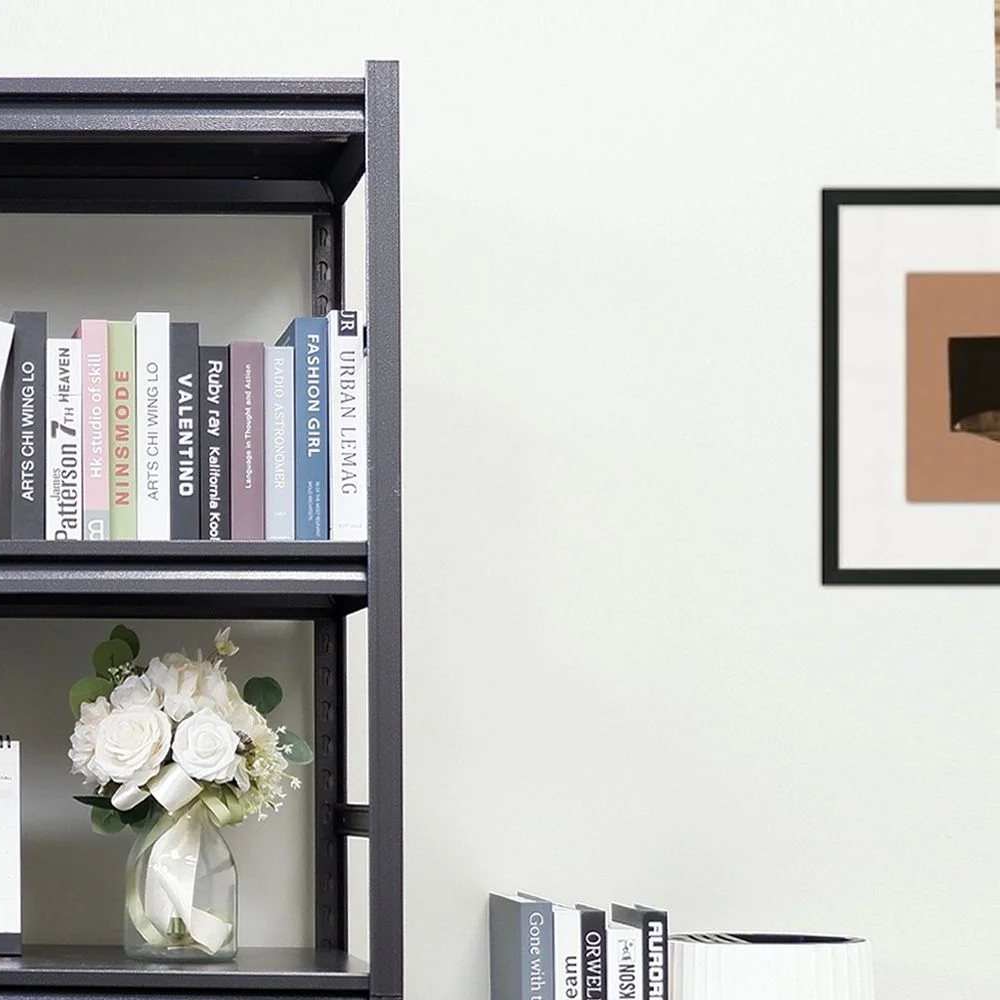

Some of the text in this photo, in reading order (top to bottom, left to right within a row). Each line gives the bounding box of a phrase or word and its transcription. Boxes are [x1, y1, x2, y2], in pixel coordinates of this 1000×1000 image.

[58, 347, 70, 403] HEAVEN
[207, 359, 224, 406] Ruby
[244, 364, 252, 390] Action
[244, 391, 252, 405] and
[307, 334, 321, 458] FASHION GIRL
[21, 361, 35, 501] ARTS CHI WING LO
[88, 353, 102, 478] Hk studio of skill
[114, 370, 130, 506] NINSMODE
[146, 361, 160, 501] ARTS CHI WING LO
[177, 373, 195, 498] VALENTINO
[207, 411, 221, 438] ray
[244, 407, 252, 439] Thought
[273, 358, 286, 490] RADIO ASTRONOMER
[339, 351, 358, 495] URBAN LEMAG
[50, 467, 61, 500] James
[55, 443, 78, 541] Patterson
[208, 446, 222, 510] Kalifornia
[244, 449, 252, 490] Language
[529, 912, 544, 956] Gone
[530, 957, 545, 990] with
